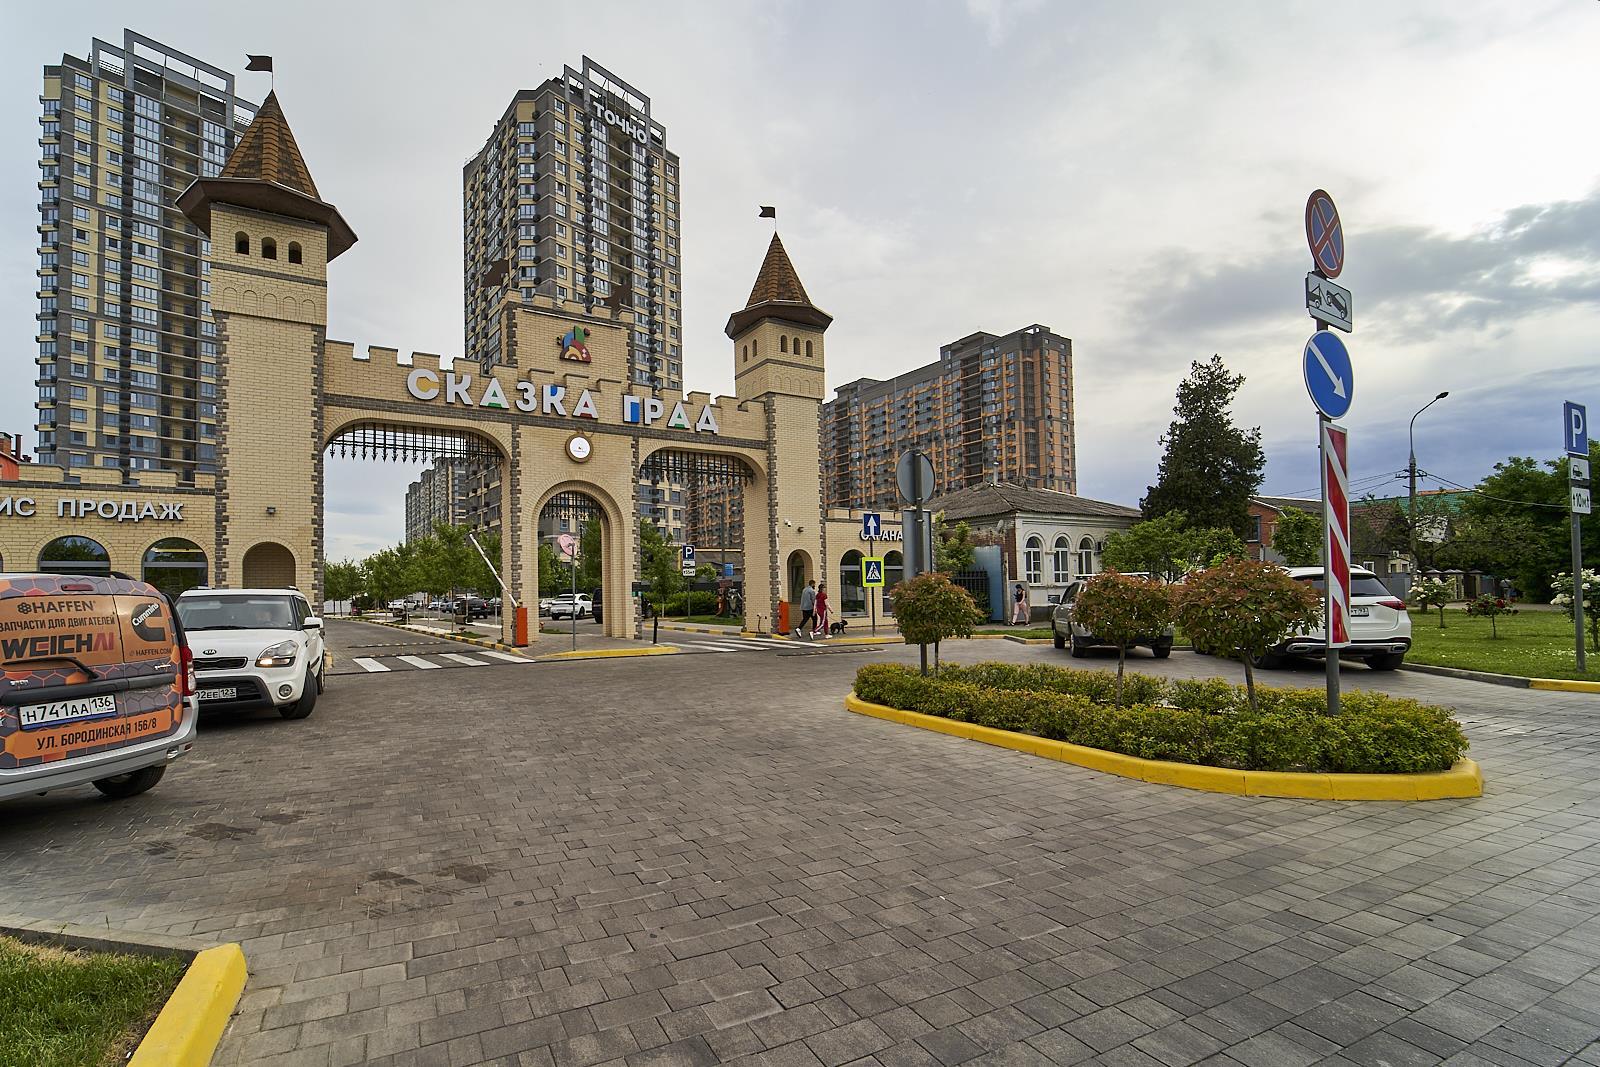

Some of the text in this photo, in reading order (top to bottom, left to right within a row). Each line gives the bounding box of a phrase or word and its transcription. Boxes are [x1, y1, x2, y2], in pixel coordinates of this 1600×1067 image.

[593, 101, 647, 144] ТОЧНО
[407, 368, 718, 435] СКАЗКА ГРАД
[1571, 408, 1583, 448] P
[57, 498, 184, 522] ПРОДАЖ
[685, 546, 693, 558] P
[32, 600, 94, 614] HAFFEN
[132, 602, 160, 626] Cummins
[0, 615, 116, 632] ЗАПЧАСТИ ДЛЯ ДВИГАТЕЛЕЙ
[91, 696, 111, 709] 136
[37, 717, 157, 750] УЛ. БОРОДИНСКАЯ 156/8
